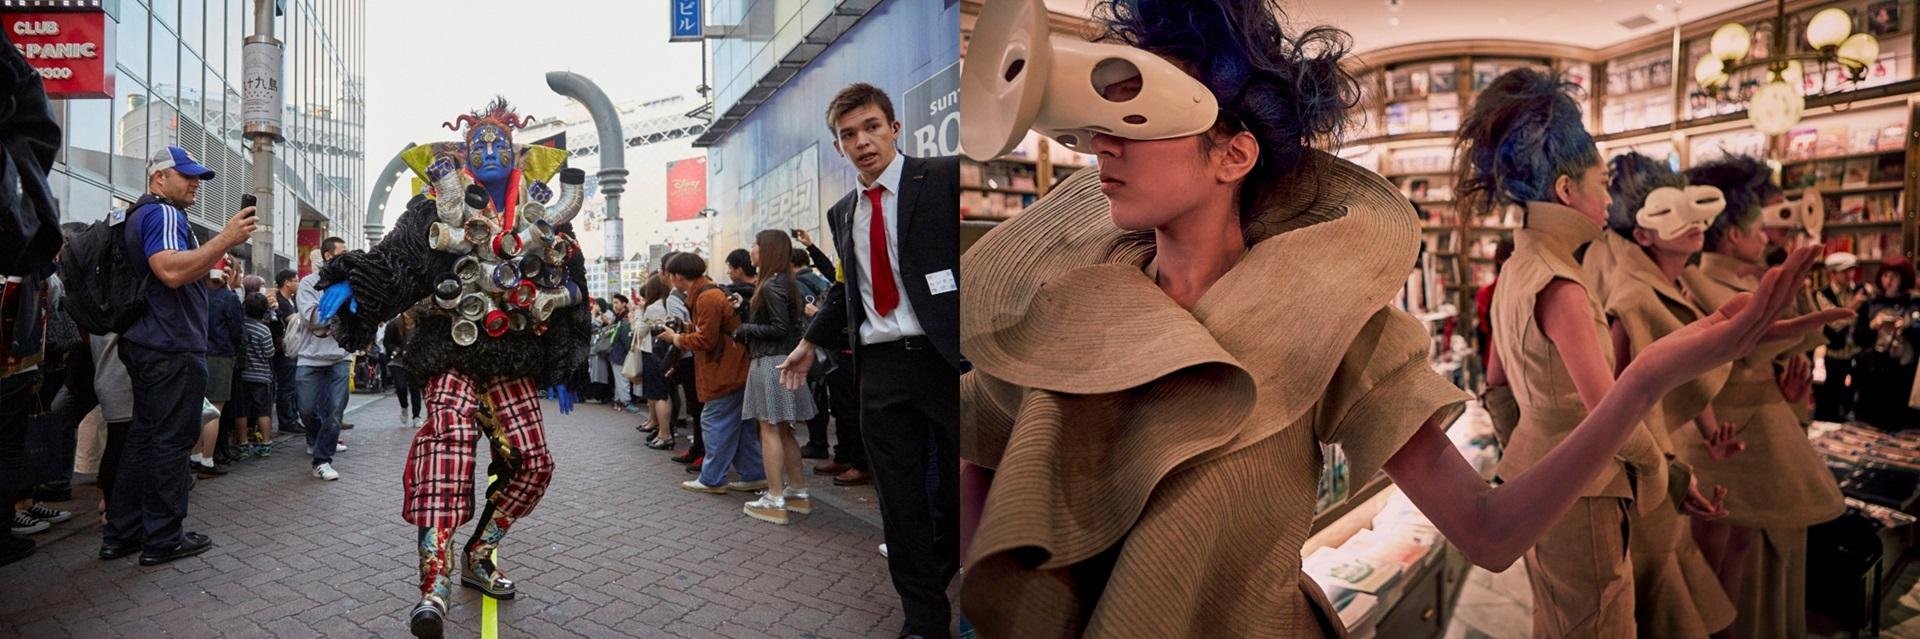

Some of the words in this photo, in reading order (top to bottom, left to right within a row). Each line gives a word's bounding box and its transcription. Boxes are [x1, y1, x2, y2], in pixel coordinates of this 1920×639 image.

[13, 20, 60, 35] CLUB
[26, 42, 97, 59] PANIC
[929, 87, 960, 116] sun
[759, 179, 813, 225] PEPSI
